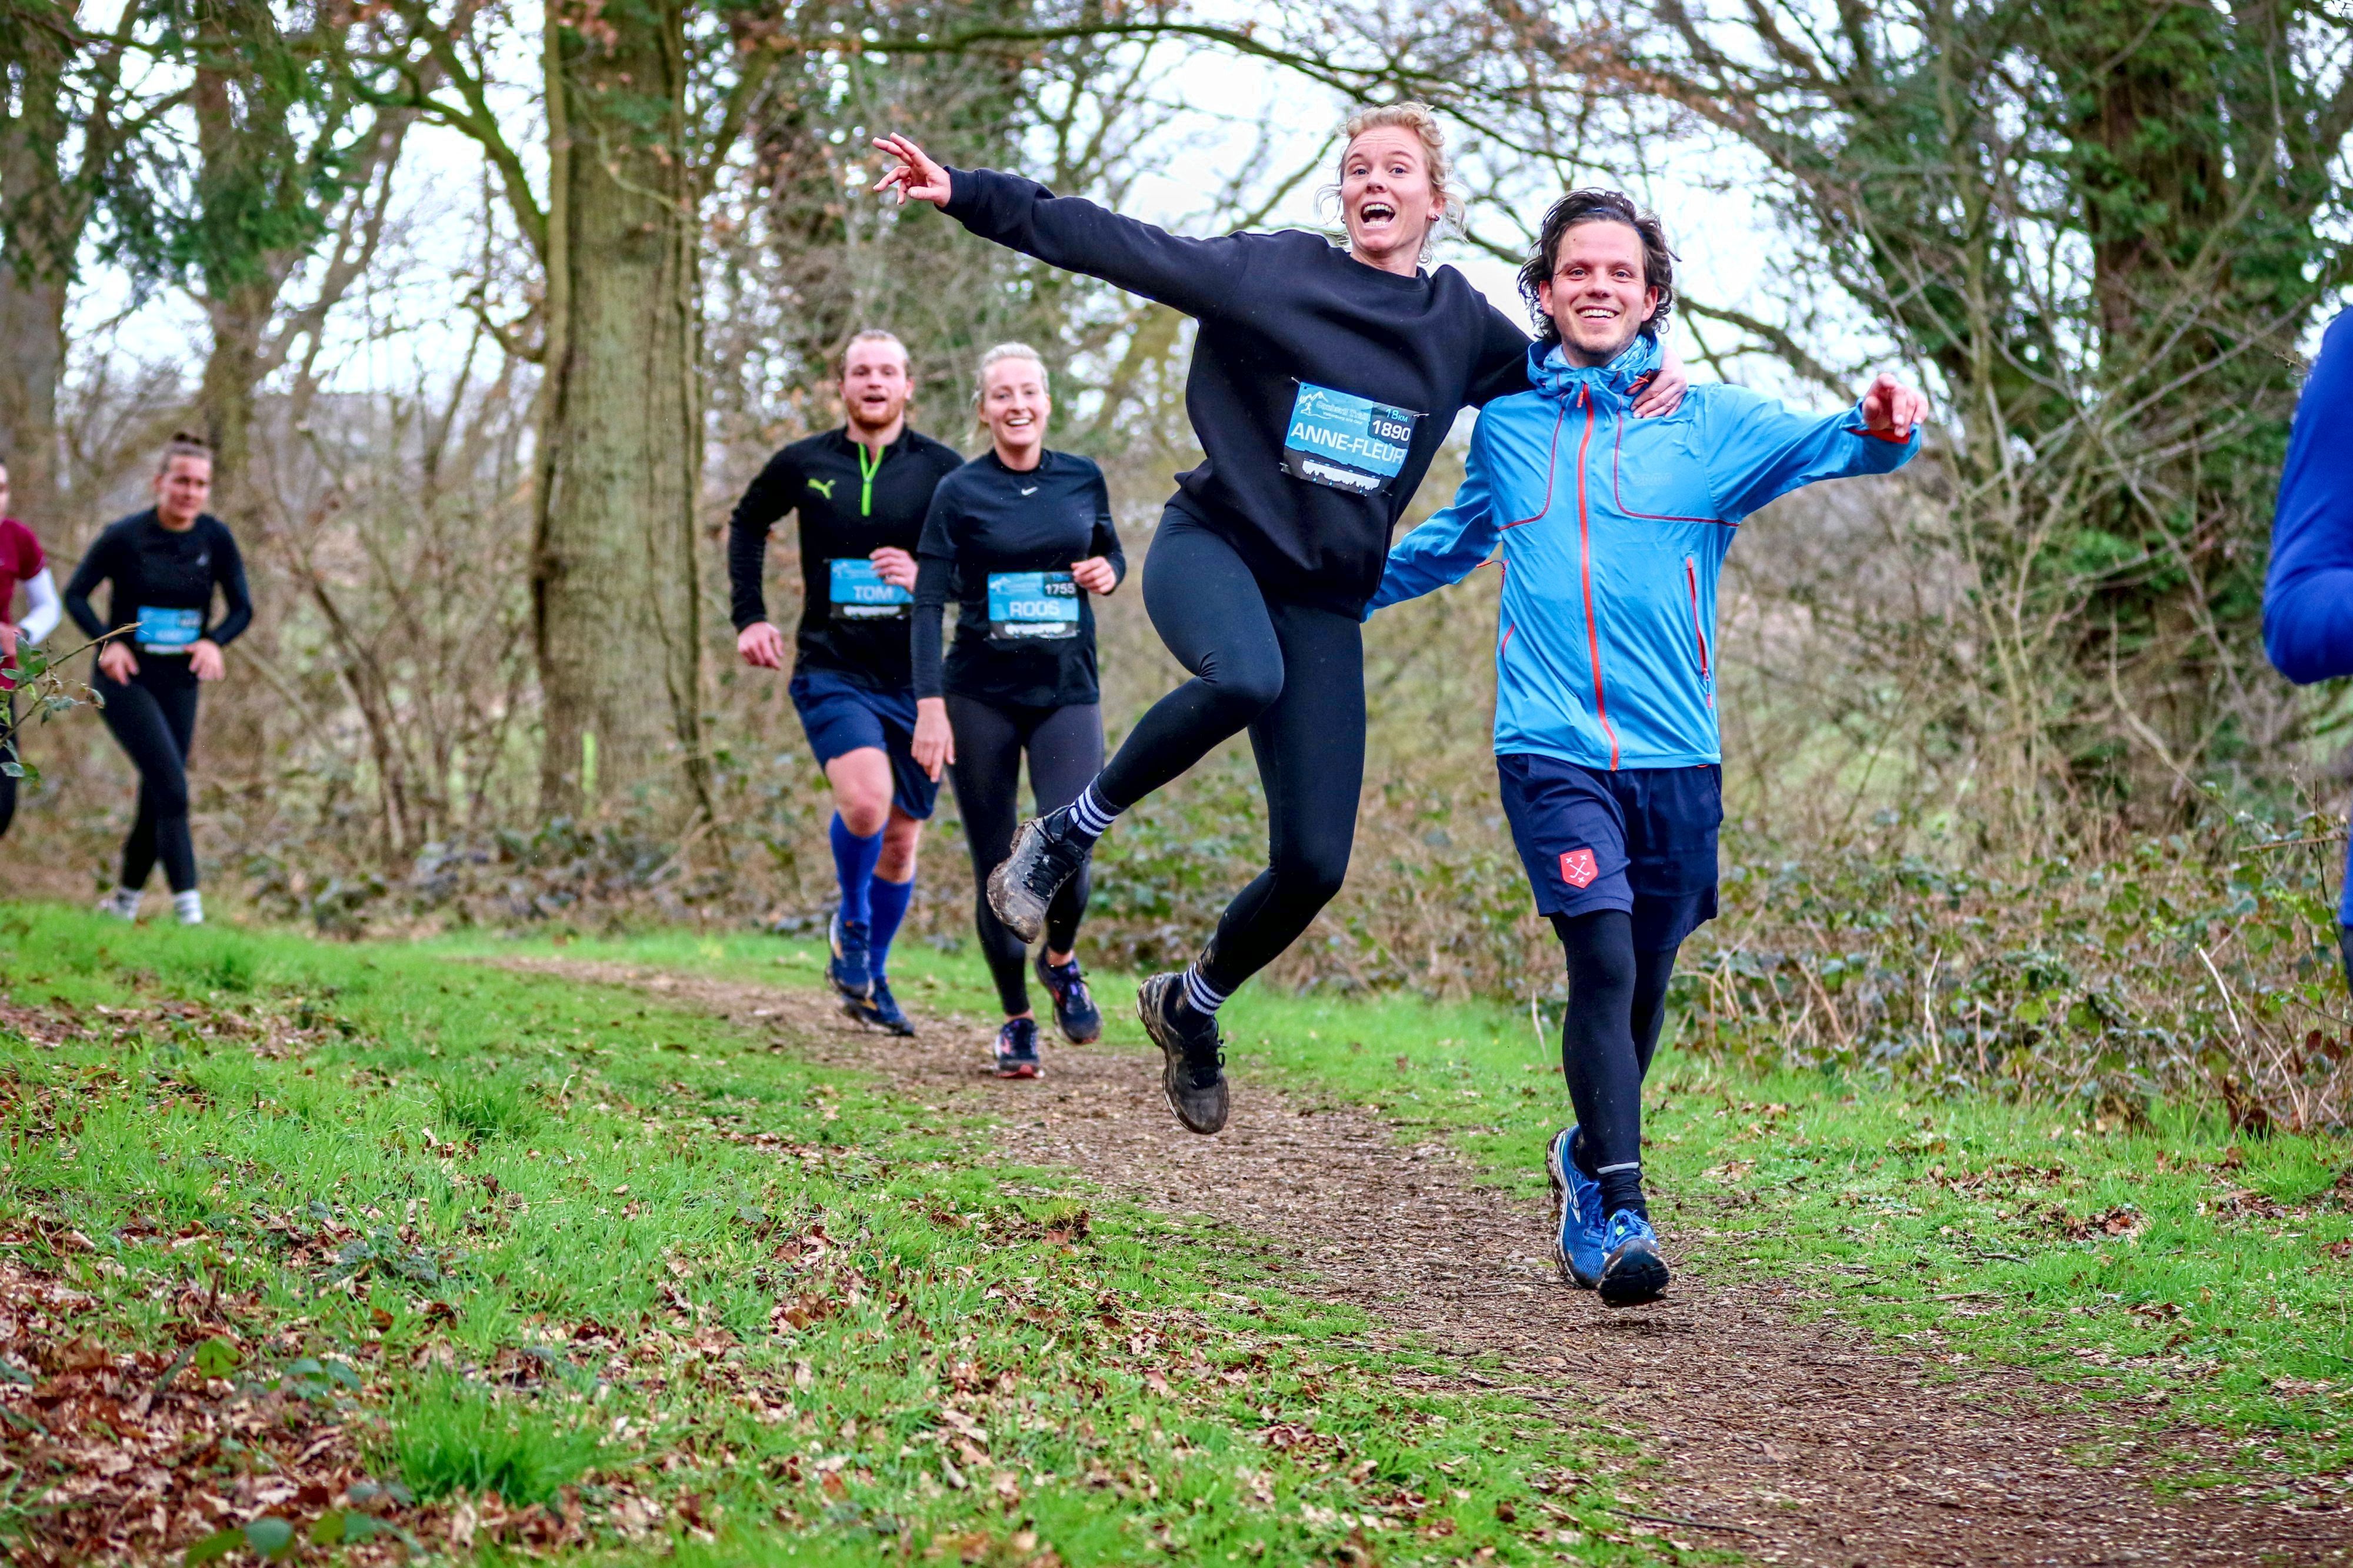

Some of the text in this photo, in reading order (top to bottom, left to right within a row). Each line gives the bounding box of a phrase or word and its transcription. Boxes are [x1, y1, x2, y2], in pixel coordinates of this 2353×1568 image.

[1385, 408, 1409, 422] 18KM
[1372, 419, 1411, 442] 1890
[1290, 422, 1405, 465] ANNE-FLEUR
[853, 585, 894, 600] TOM
[1045, 583, 1076, 595] 1755
[1009, 600, 1060, 618] ROOS
